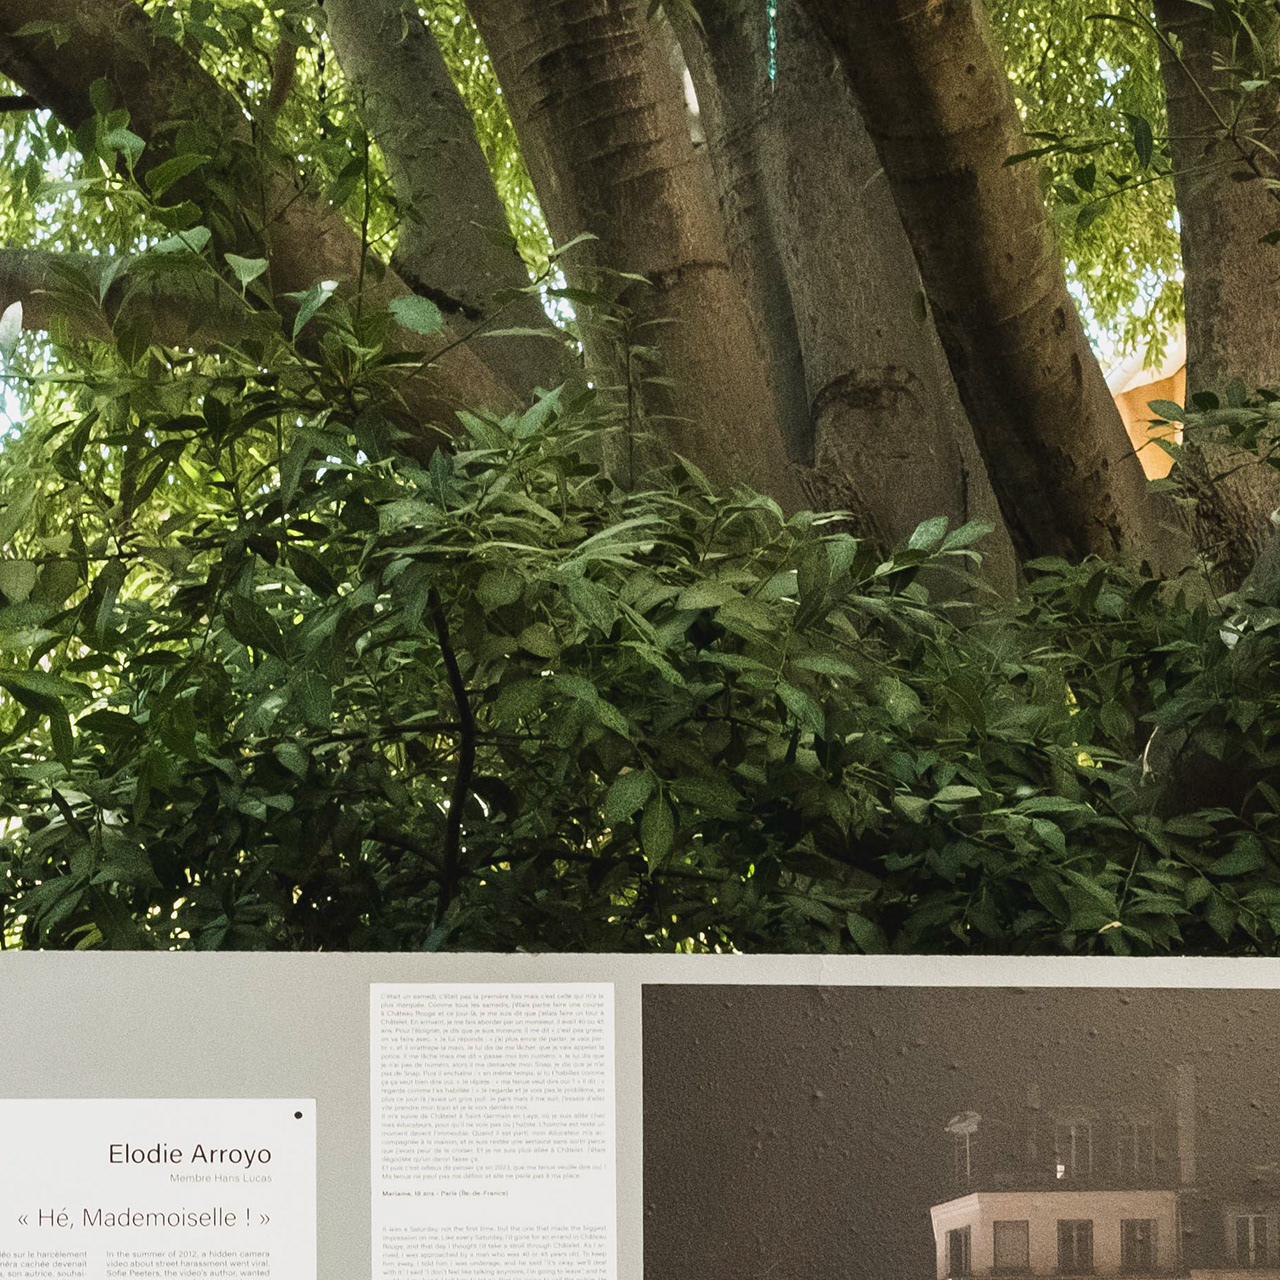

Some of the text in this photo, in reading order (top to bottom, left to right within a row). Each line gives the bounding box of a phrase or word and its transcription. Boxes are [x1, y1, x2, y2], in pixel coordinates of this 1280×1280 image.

[110, 1143, 271, 1168] Elodie Arroyo
[170, 1174, 272, 1182] Membre Hans Lucas
[18, 1207, 269, 1229] « Hé, Mademoiselle ! »
